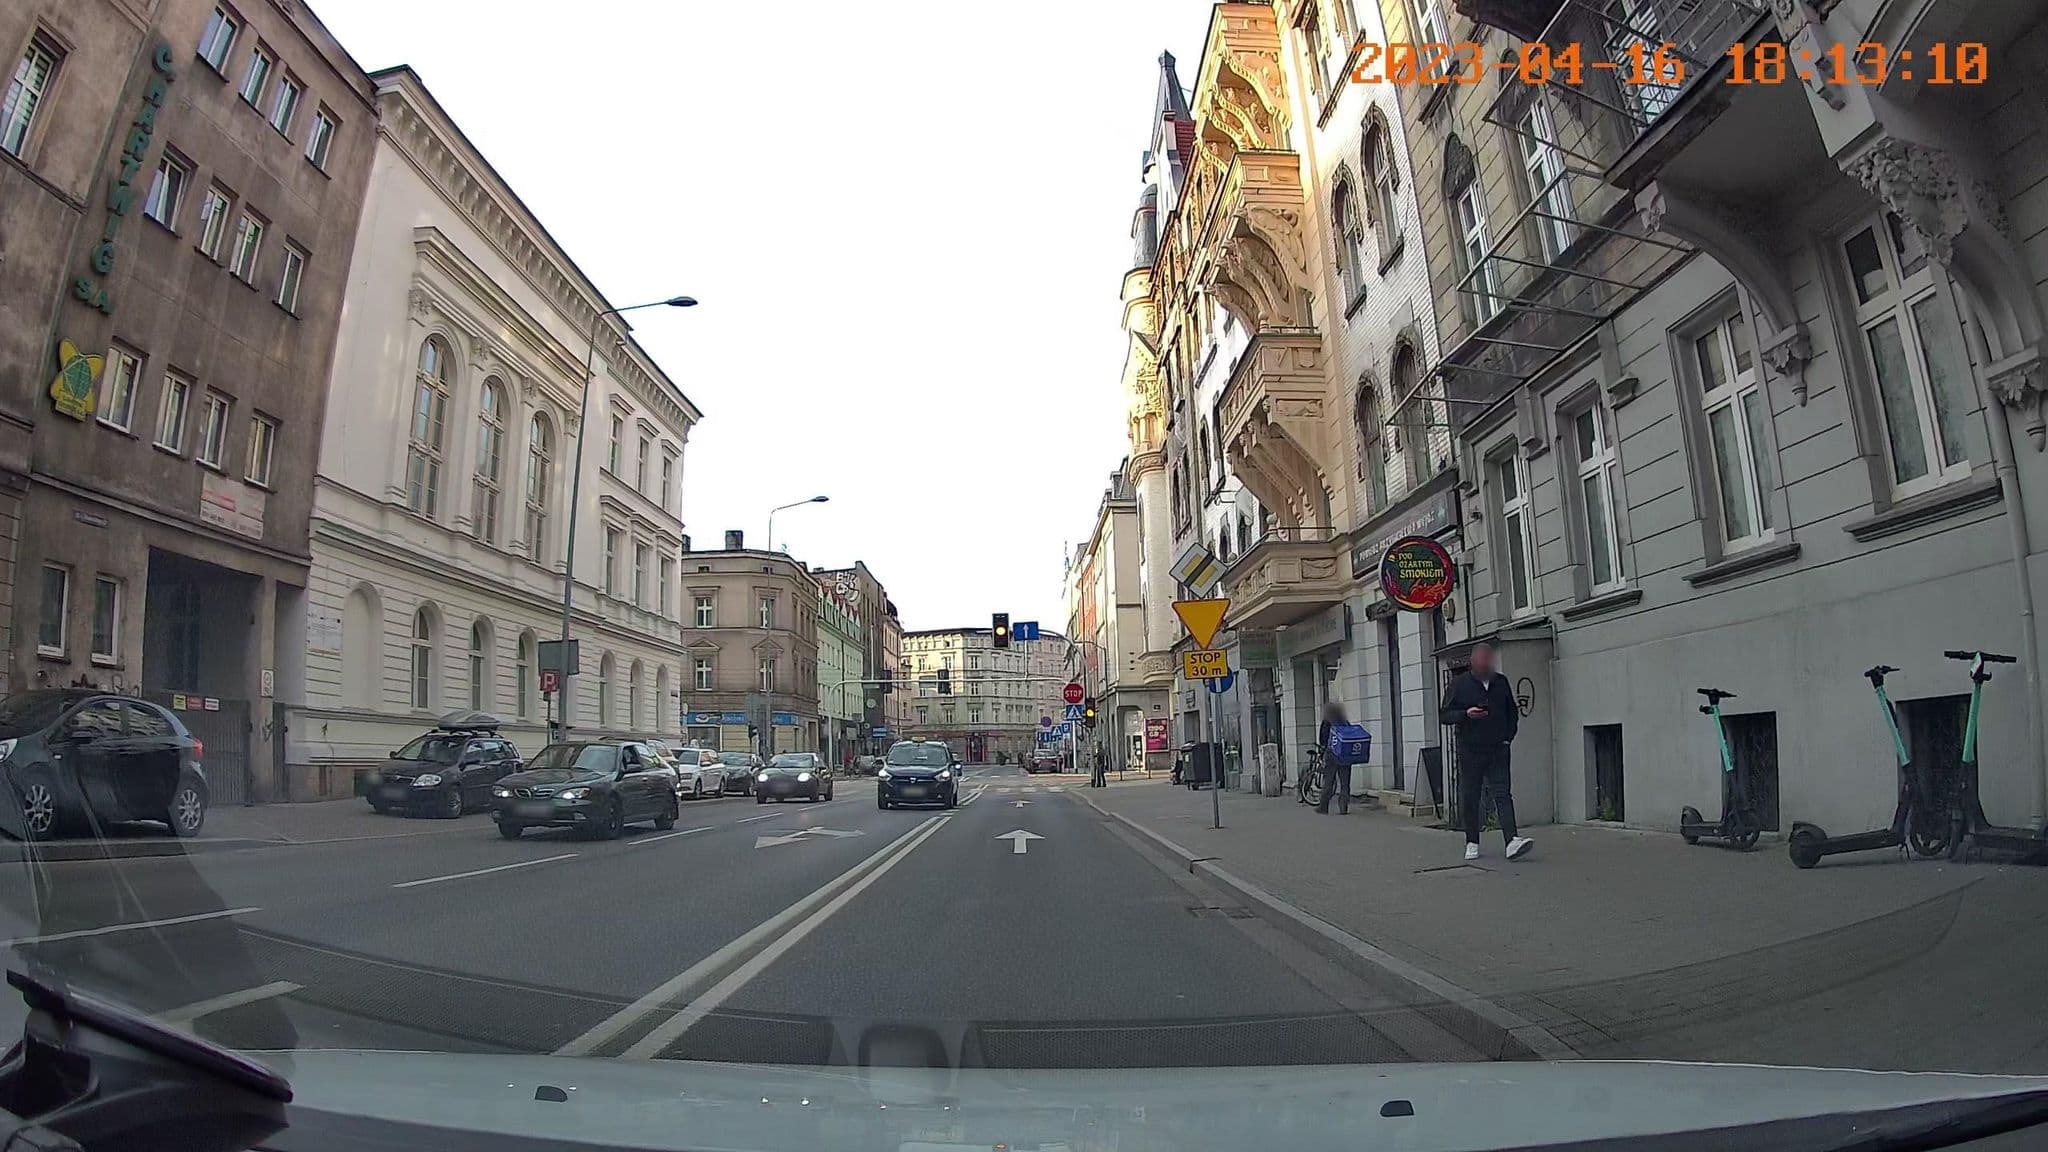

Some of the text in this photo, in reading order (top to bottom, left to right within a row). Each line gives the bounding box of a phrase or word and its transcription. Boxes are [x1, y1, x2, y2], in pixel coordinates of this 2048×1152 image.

[1190, 652, 1221, 664] STOP
[1192, 666, 1222, 676] 30 m
[1065, 690, 1082, 698] STOP
